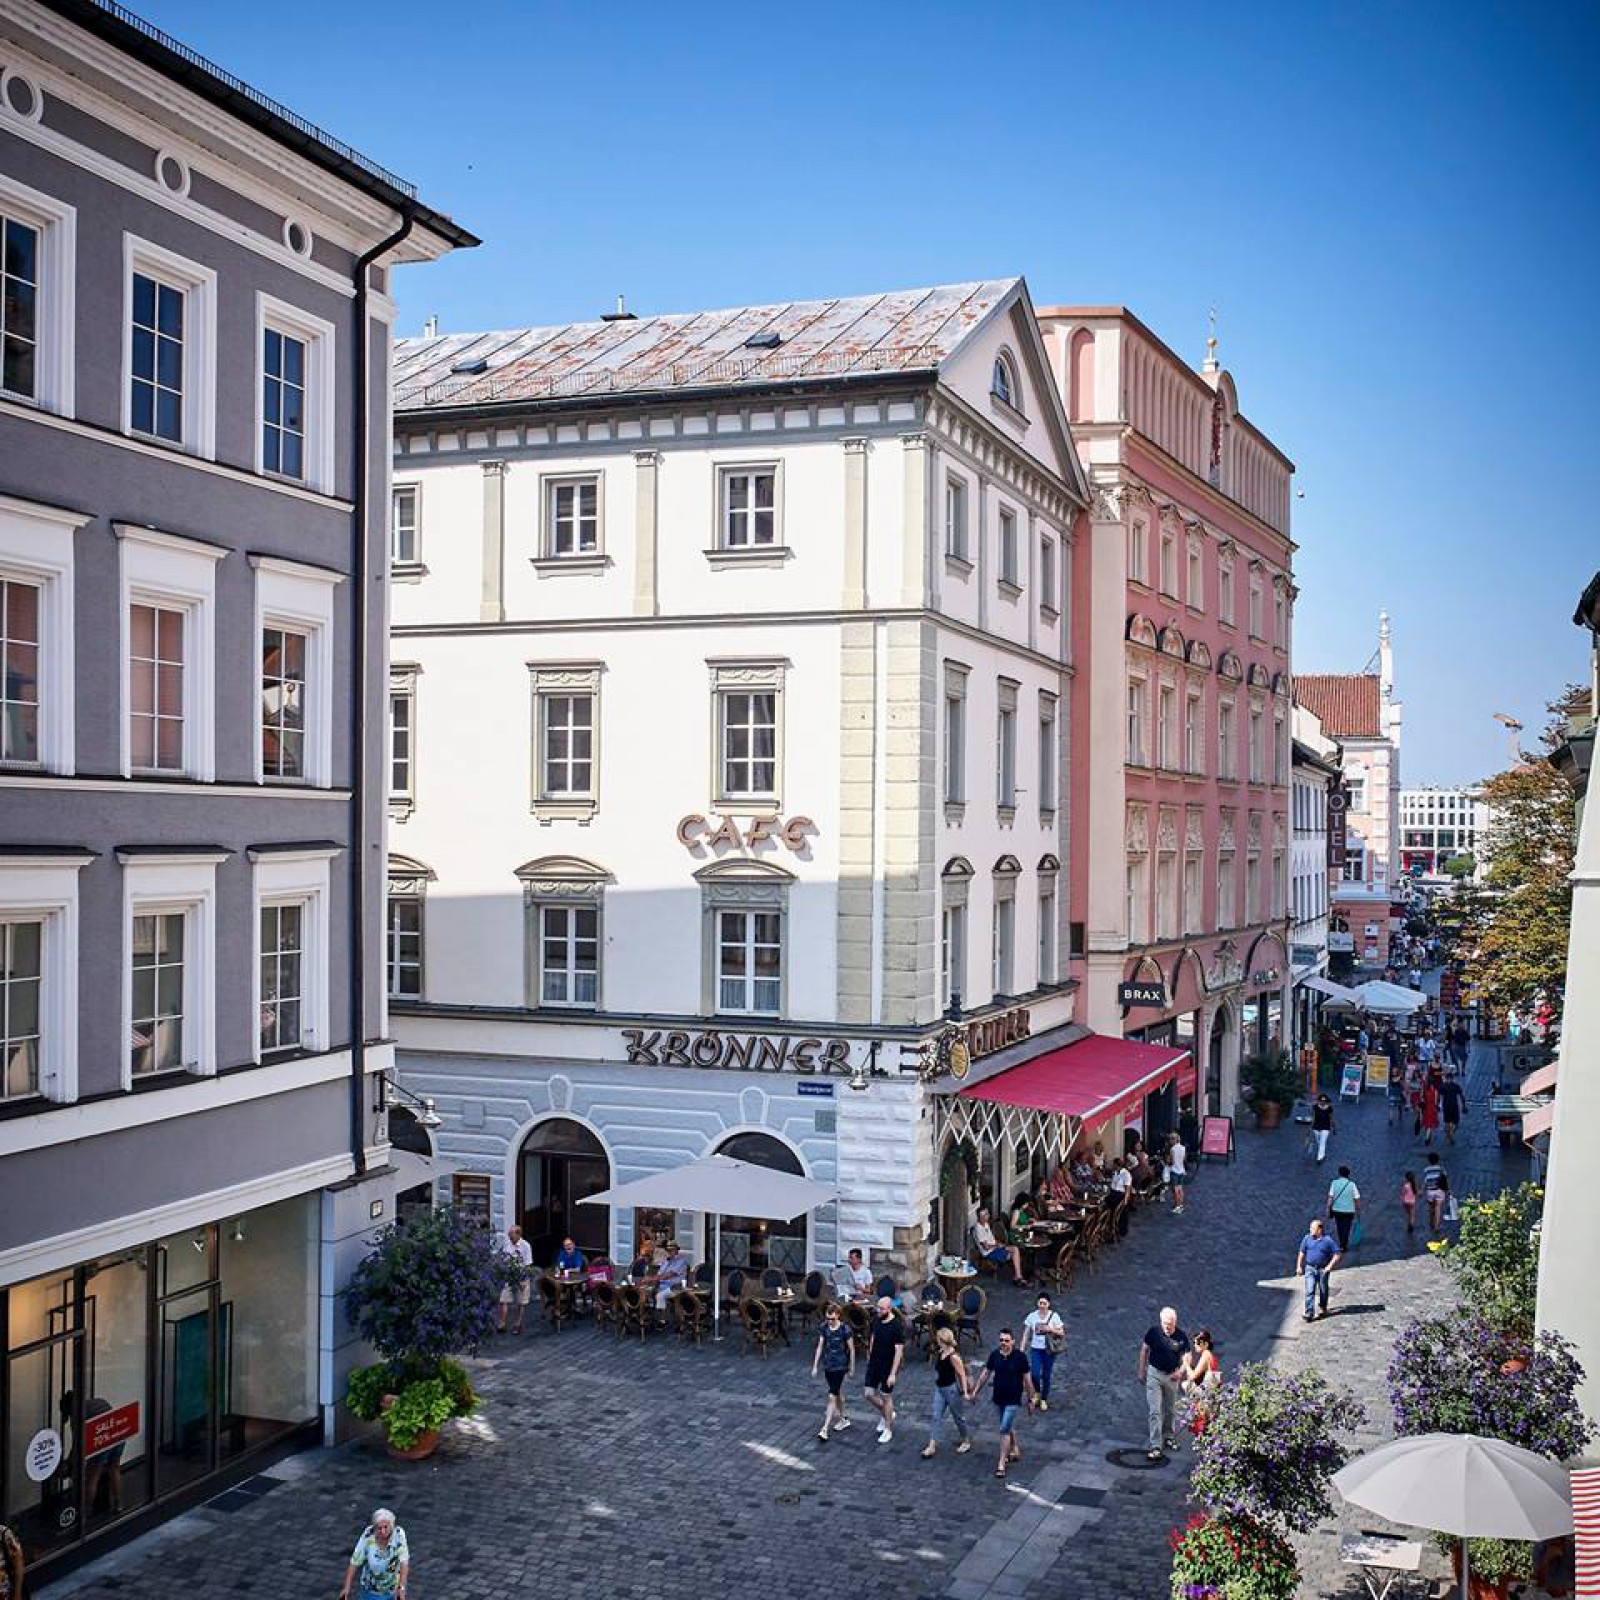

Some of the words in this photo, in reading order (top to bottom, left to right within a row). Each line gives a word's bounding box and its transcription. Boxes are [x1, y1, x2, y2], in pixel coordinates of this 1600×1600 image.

[677, 813, 813, 851] CAFE
[1124, 989, 1161, 1001] BRAX
[621, 1028, 852, 1077] KRÖNNER
